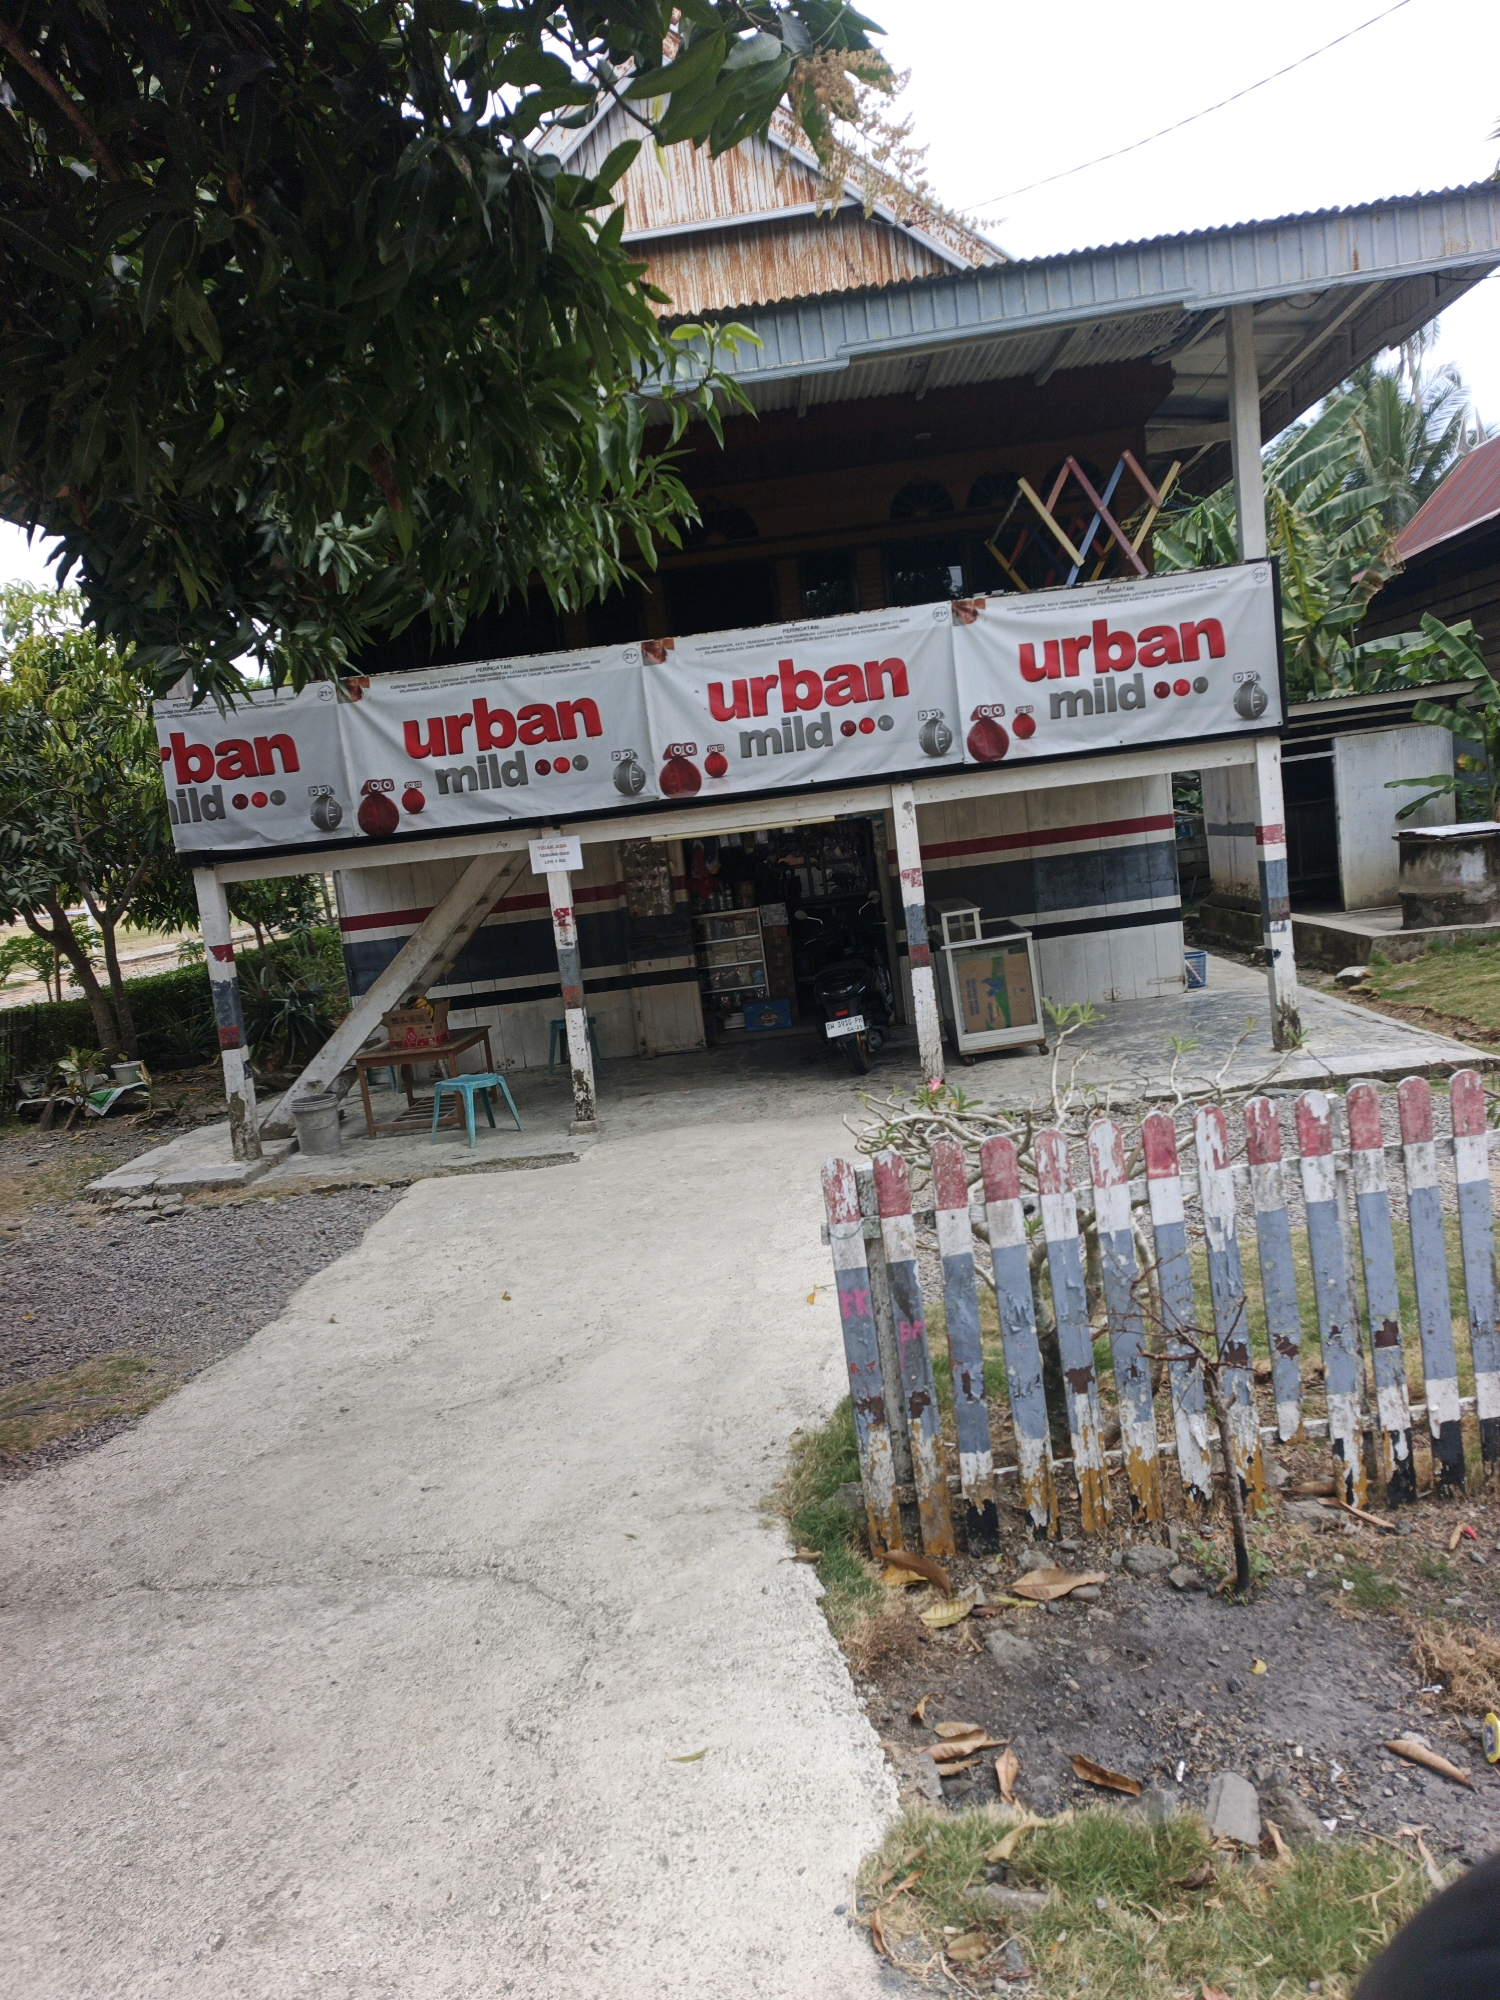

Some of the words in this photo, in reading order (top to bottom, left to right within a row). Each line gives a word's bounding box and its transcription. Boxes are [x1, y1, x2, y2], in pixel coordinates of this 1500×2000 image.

[1018, 616, 1227, 684] urban
[707, 656, 911, 722] urban
[1049, 672, 1148, 721] mild
[403, 697, 603, 759] urban
[739, 711, 835, 759] mild
[435, 750, 529, 795] mild
